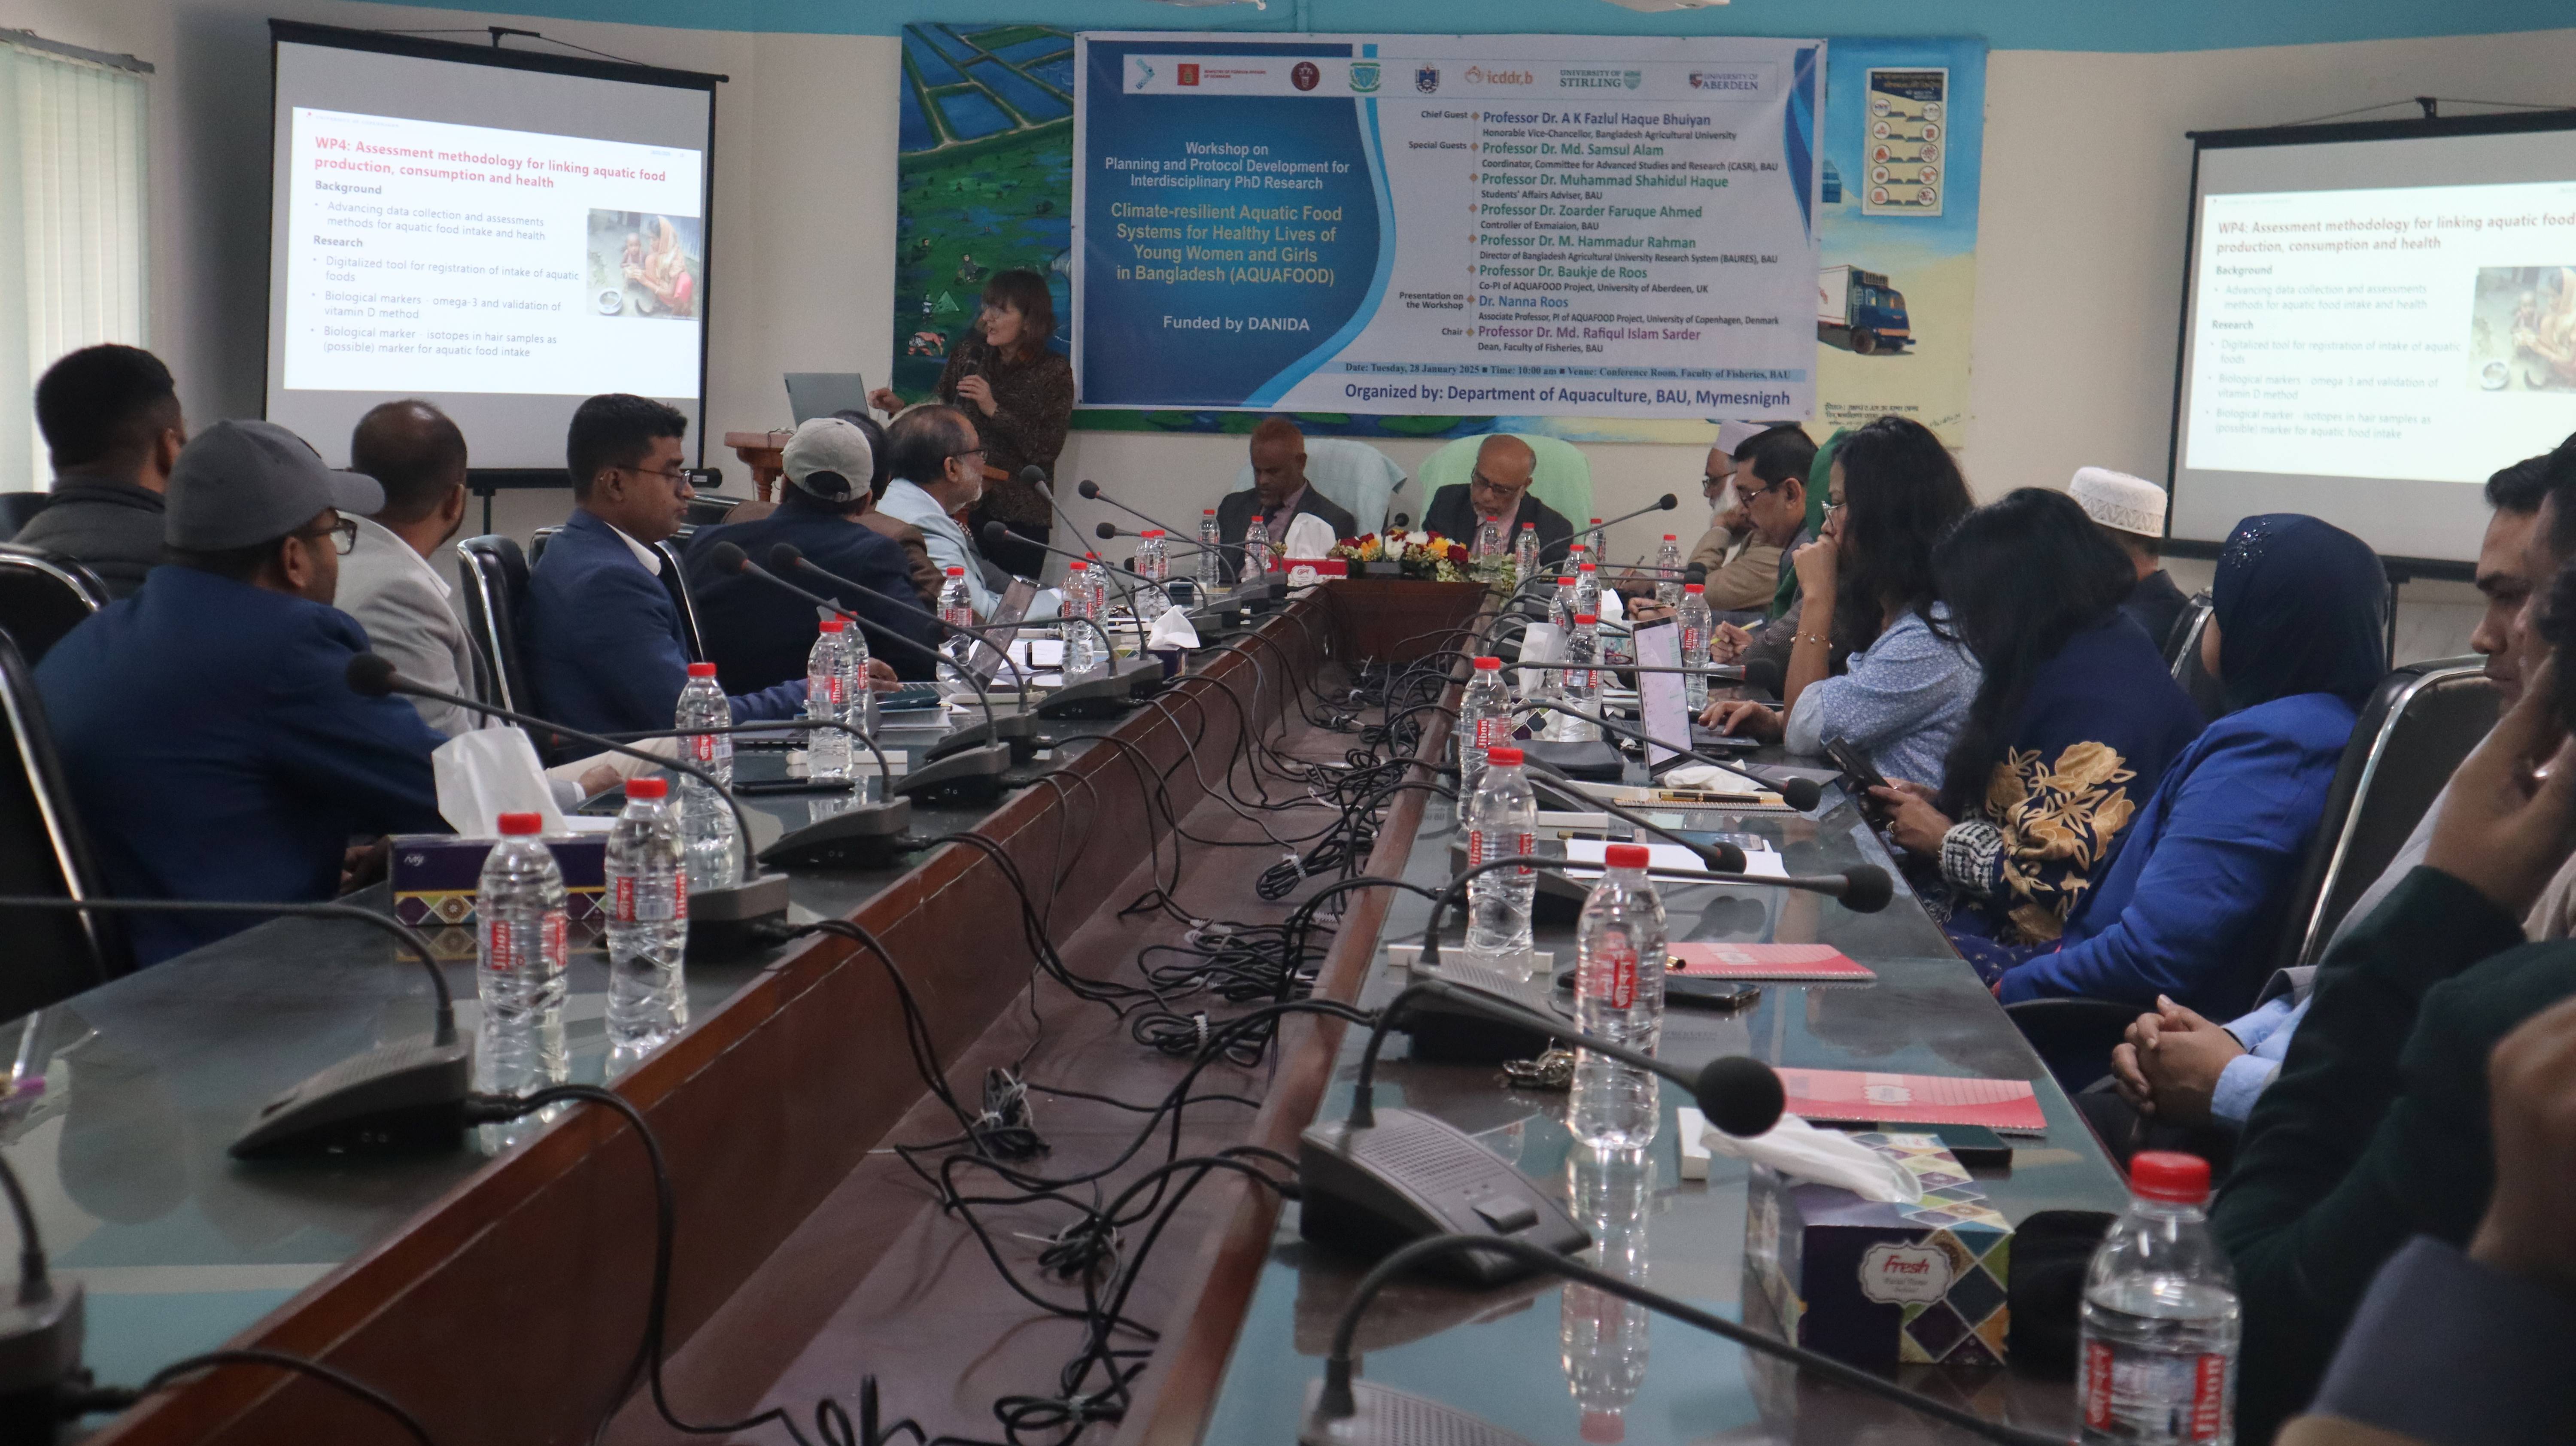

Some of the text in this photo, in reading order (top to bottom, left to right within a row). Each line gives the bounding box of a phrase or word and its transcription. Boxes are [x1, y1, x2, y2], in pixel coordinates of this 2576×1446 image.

[1487, 71, 1533, 85] icddr,b
[1560, 78, 1621, 87] STIRLING
[1703, 80, 1759, 89] ABERDEEN
[1483, 111, 1711, 127] Professor Dr. A K Fazlul Haque Bhuiyan
[1185, 142, 1268, 157] Workshop on
[1408, 141, 1437, 149] Special
[1482, 142, 1664, 155] Professor Dr. Md. Samsul Alam
[316, 137, 665, 181] WP4: Assessment methodology for linking aquatic food
[1105, 157, 1350, 173] Planning and Protocol Development for
[315, 158, 554, 188] production, consumption and health
[1482, 173, 1728, 189] Professor Dr. Muhammad Shahidul Haque
[315, 180, 382, 194] Background
[1131, 174, 1323, 190] Interdisciplinary PhD Research
[1111, 203, 1342, 222] Climate-resilient Aquatic Food
[1481, 203, 1702, 219] Professor Dr. Zoarder Faruque Ahmed
[2218, 212, 2576, 234] WP4: Assessment methodology for linking aquatic food
[313, 235, 363, 247] Research
[1117, 223, 1337, 243] Systems for Healthy Lives of
[1480, 234, 1696, 248] Professor Dr. M. Hammadur Rahman
[1134, 244, 1318, 263] Young Women and Girls
[2216, 237, 2441, 255] production, consumption and health
[1117, 264, 1334, 285] in Bangladesh (AQUAFOOD)
[1479, 264, 1647, 279] Professor Dr. Baukje de Roos
[2215, 265, 2272, 276] Background
[1422, 301, 1464, 310] Workshop
[1479, 295, 1568, 307] Dr. Nanna Roos
[1163, 315, 1309, 332] Funded by DANIDA
[2211, 319, 2254, 329] Research
[1478, 325, 1701, 340] Professor Dr. Md. Rafiqul Islam Sarder
[1477, 342, 1501, 351] Dean,
[1504, 343, 1533, 352] Faculty
[1545, 343, 1583, 352] Fisheries,
[1346, 363, 1368, 371] Date:
[1371, 363, 1407, 374] Tuesday,
[1410, 364, 1420, 372] 28
[1422, 364, 1456, 374] January
[1459, 365, 1479, 374] 2025
[1490, 365, 1514, 374] Time:
[1519, 366, 1541, 374] 10:00
[1567, 367, 1596, 375] Venue:
[1599, 368, 1648, 376] Conference
[1651, 368, 1679, 377] Room,
[1681, 369, 1712, 378] Faculty
[1726, 370, 1767, 378] Fisheries,
[1770, 371, 1790, 379] BAU
[1345, 384, 1790, 407] Organized by: Department of Aquaculture, BAU, Mymesnignh
[832, 678, 840, 703] Jibon
[1478, 720, 1488, 748] Jibon
[677, 876, 686, 918] Jibon
[493, 923, 507, 968] Jibon
[1615, 962, 1631, 1006] জীবন
[1883, 1255, 1930, 1274] Fresh
[2195, 1358, 2223, 1435] Jibon
